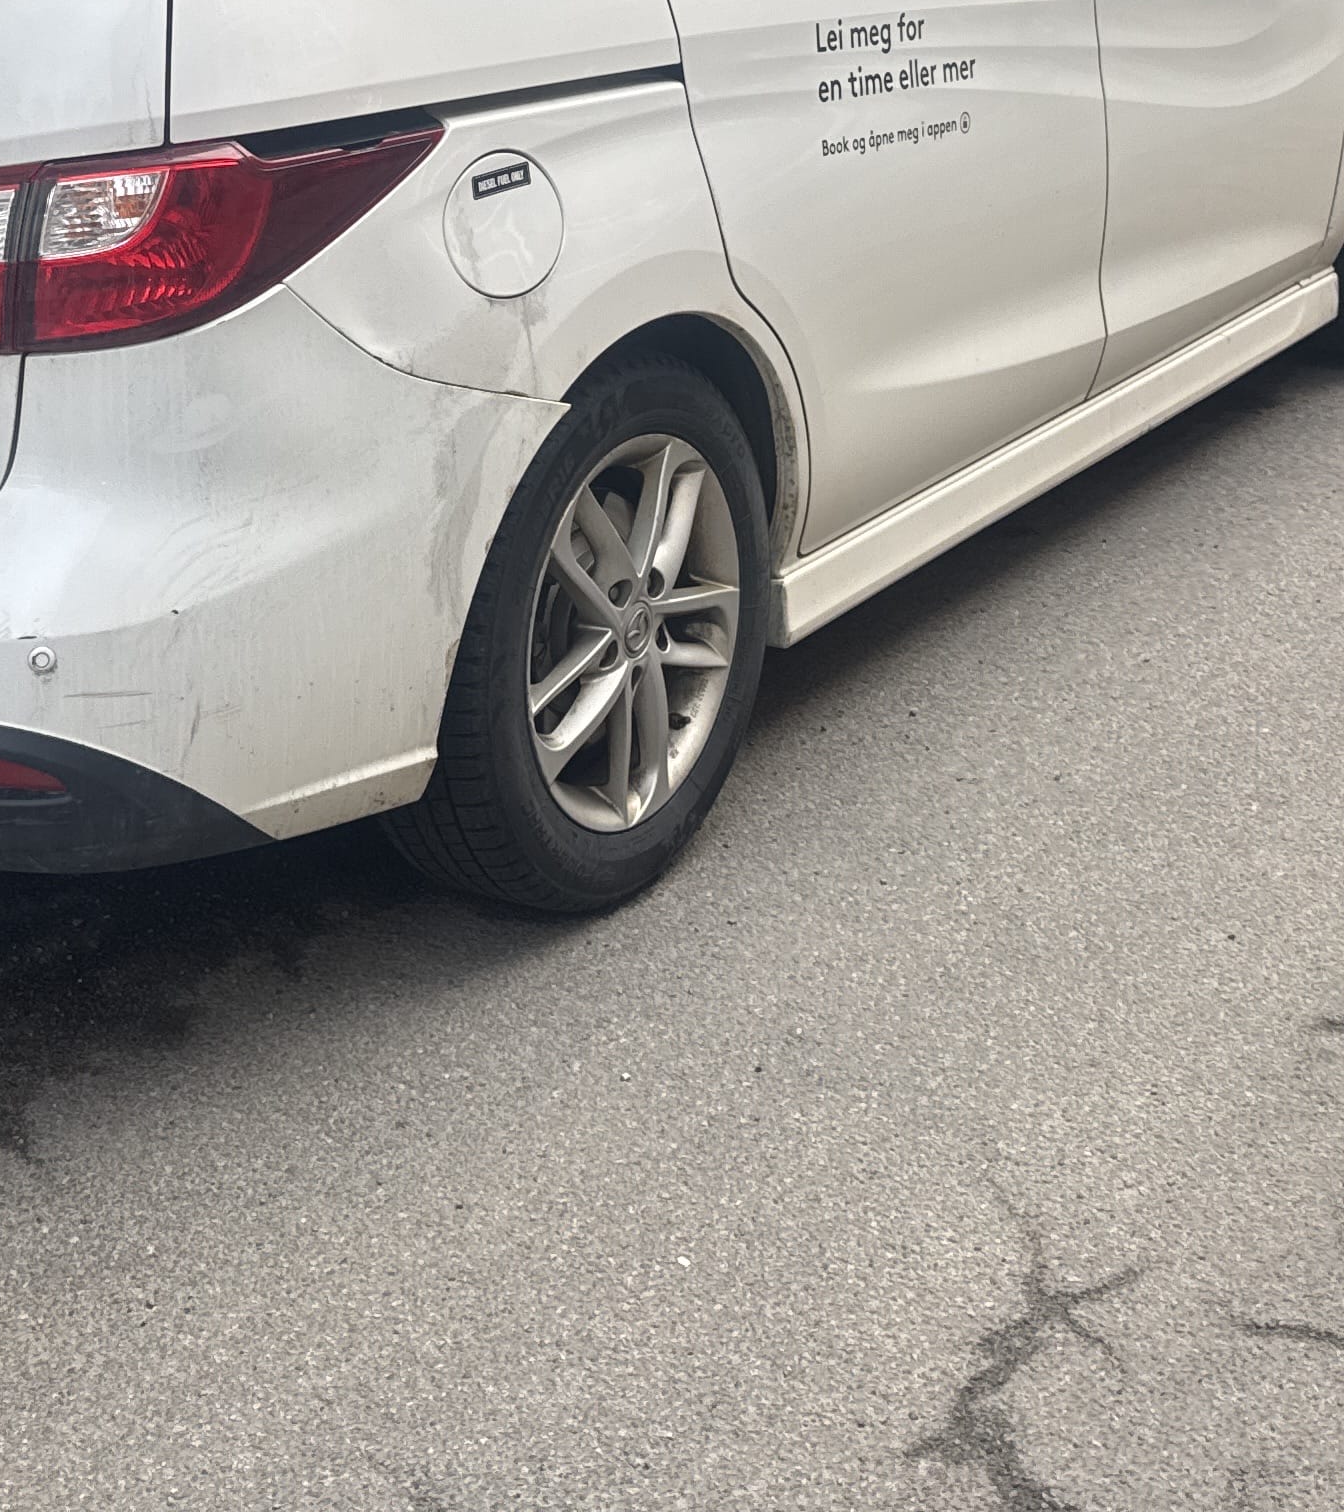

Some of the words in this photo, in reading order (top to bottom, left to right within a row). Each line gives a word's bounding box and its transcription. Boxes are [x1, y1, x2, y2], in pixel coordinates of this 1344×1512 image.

[816, 19, 843, 53] Lei
[850, 23, 891, 54] meg
[897, 12, 925, 42] for
[818, 78, 842, 102] en
[848, 65, 894, 98] time
[899, 58, 937, 90] eller
[943, 58, 976, 83] mer
[821, 136, 850, 157] Book
[852, 137, 866, 155] og
[868, 130, 895, 151] åpne
[897, 127, 919, 144] meg
[921, 121, 925, 137] i
[927, 119, 957, 140] appen
[478, 178, 497, 193] DIESEL
[497, 173, 511, 186] FUEL
